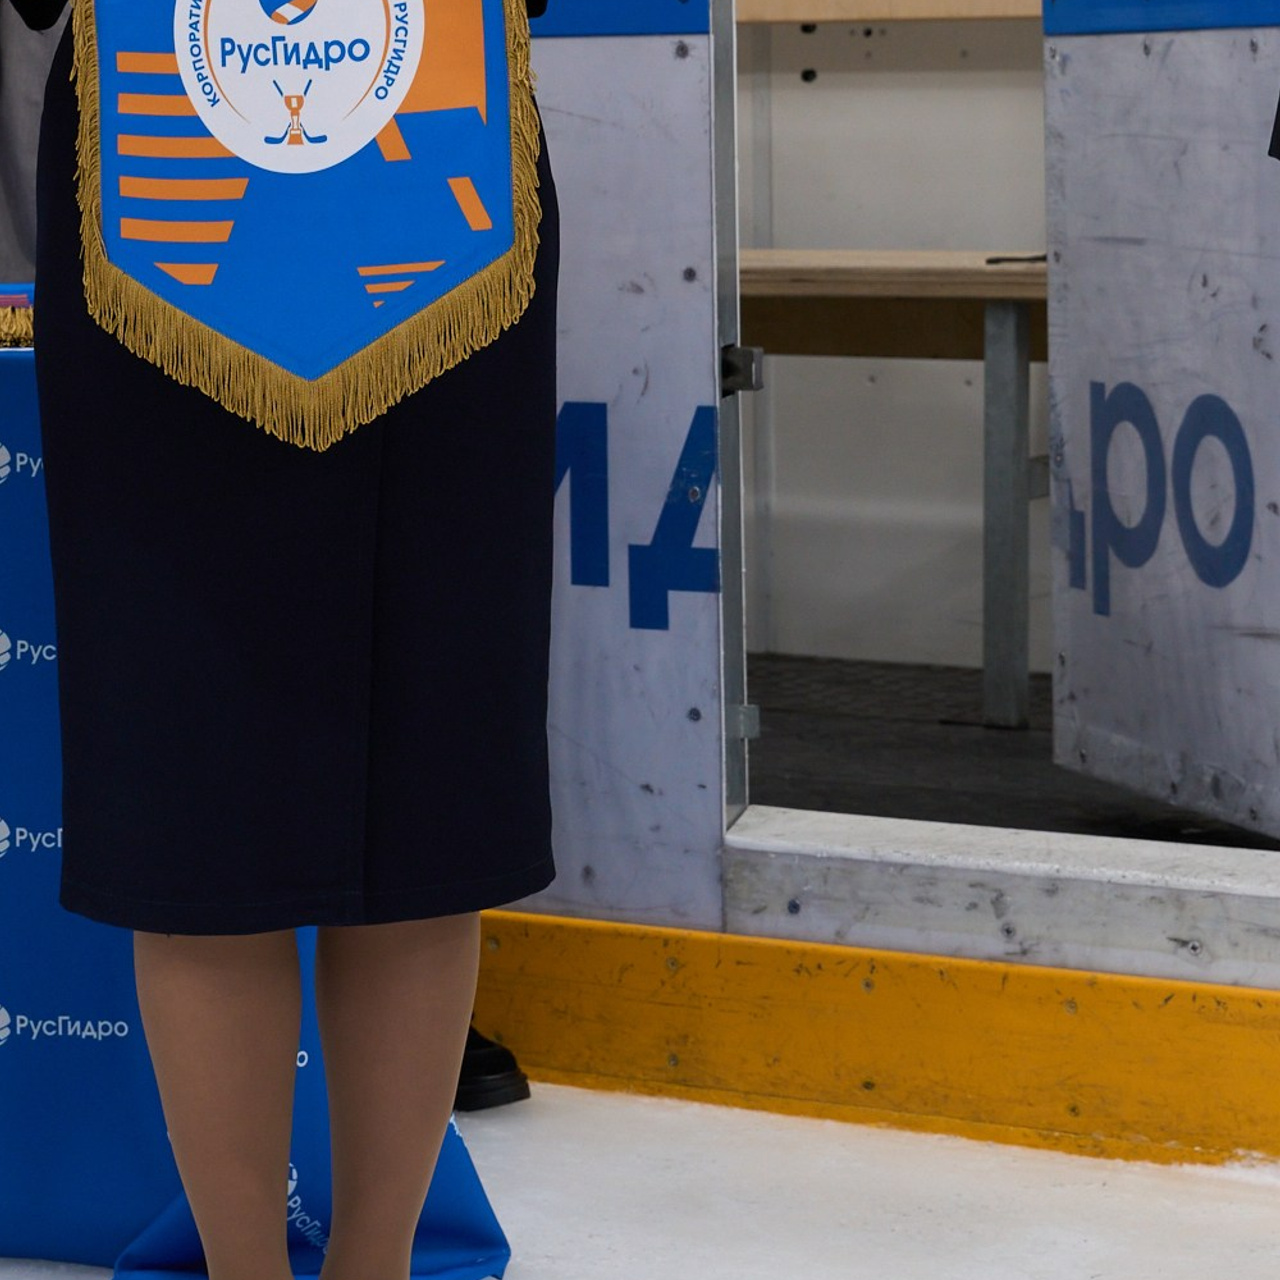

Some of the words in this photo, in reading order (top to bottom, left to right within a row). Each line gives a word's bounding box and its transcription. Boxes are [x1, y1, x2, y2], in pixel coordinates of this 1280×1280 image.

[221, 35, 371, 73] РусГидро
[374, 1, 409, 101] РУСГИДРО
[16, 1014, 129, 1041] РусГидро
